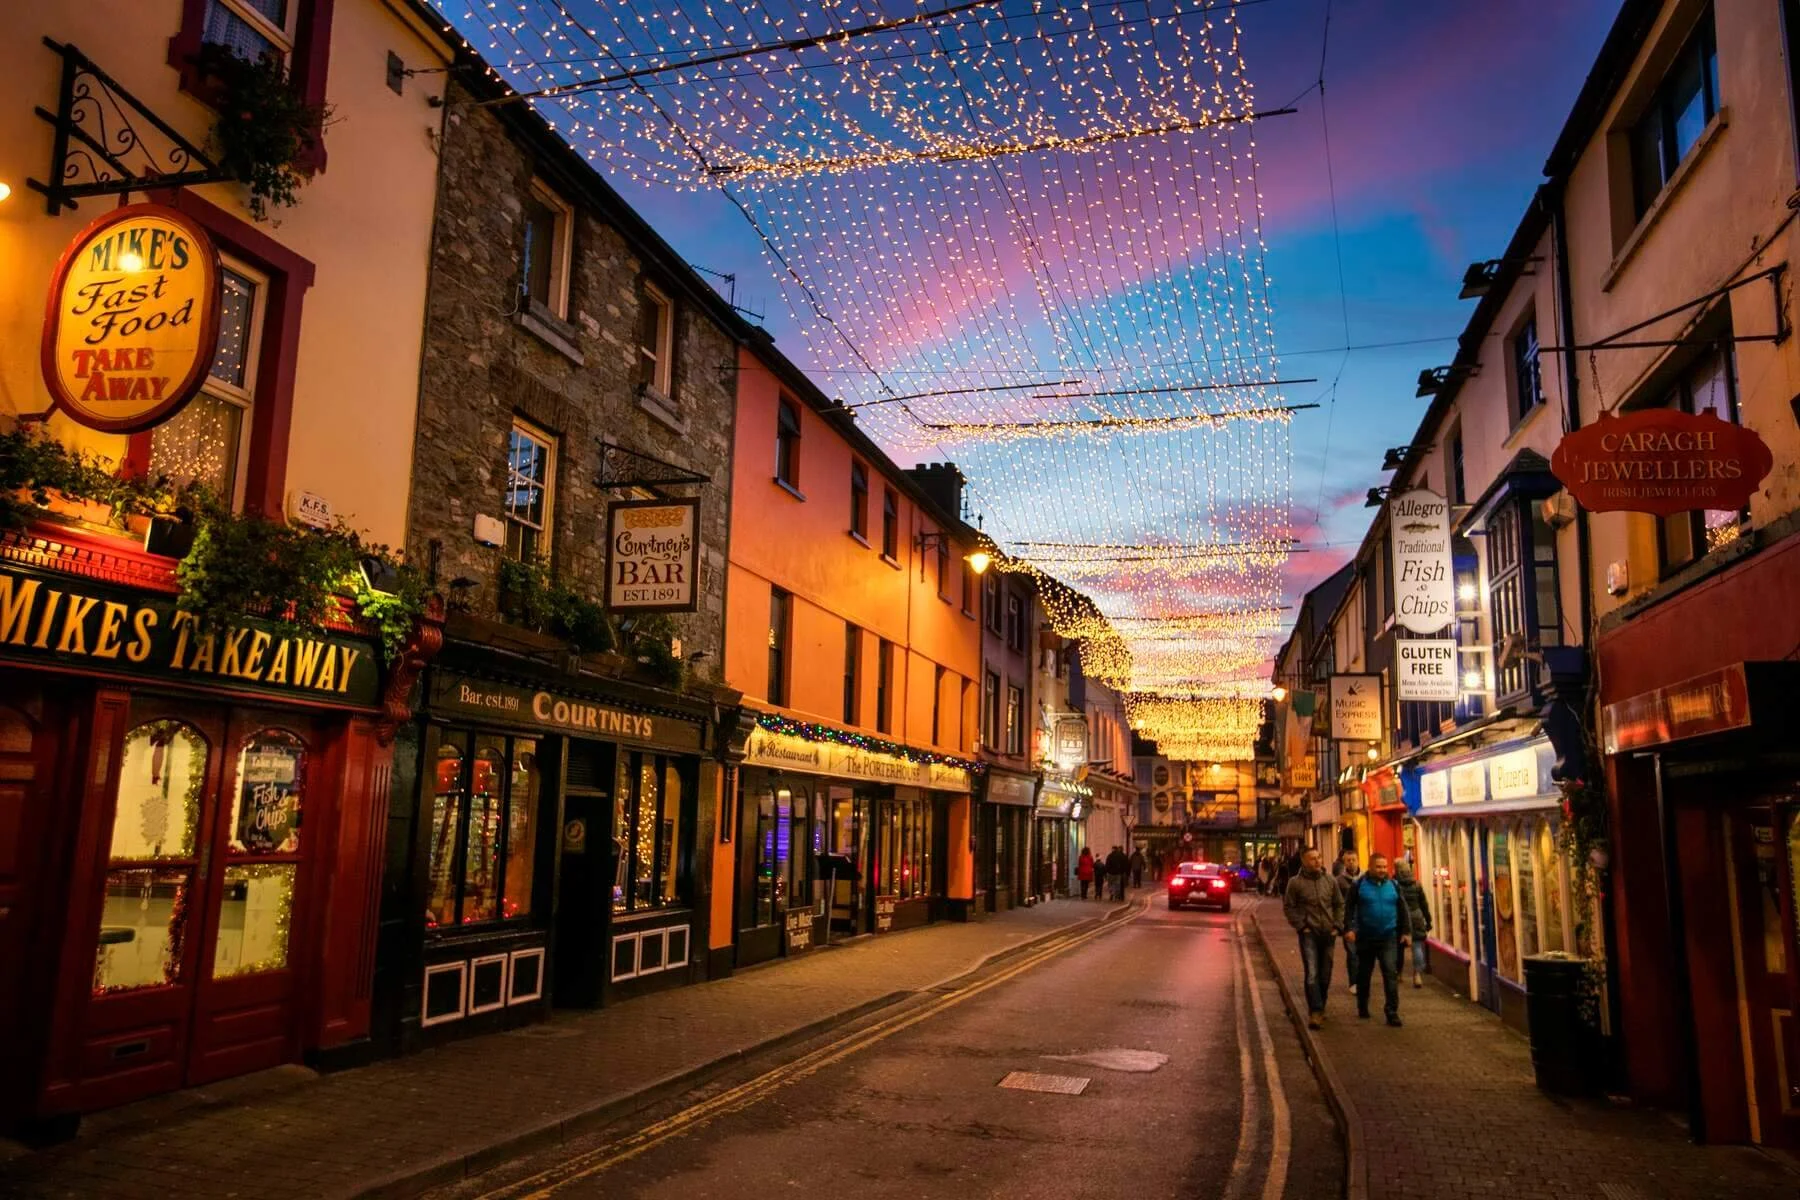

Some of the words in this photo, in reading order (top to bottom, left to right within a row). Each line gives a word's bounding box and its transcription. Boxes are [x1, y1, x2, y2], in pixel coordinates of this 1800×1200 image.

[90, 227, 189, 272] MIKE'S
[72, 275, 168, 315] Fast
[85, 298, 194, 344] Food
[72, 347, 154, 378] TAKE
[80, 372, 170, 401] AWAY
[1601, 431, 1716, 453] CARAGH
[1579, 459, 1742, 484] JEWELLERS
[1603, 486, 1637, 498] IRISH
[1395, 499, 1444, 518] Allegro
[615, 530, 690, 562] Courtney's
[1398, 539, 1445, 554] Traditional
[616, 561, 685, 585] BAR
[1400, 560, 1445, 582] Fish
[1401, 594, 1449, 617] Chips
[0, 574, 158, 663] MIKES
[1401, 647, 1452, 660] GLUTEN
[1411, 663, 1443, 675] FREE
[766, 740, 813, 762] Restaurant
[253, 781, 279, 808] Fish
[255, 805, 288, 830] Chips
